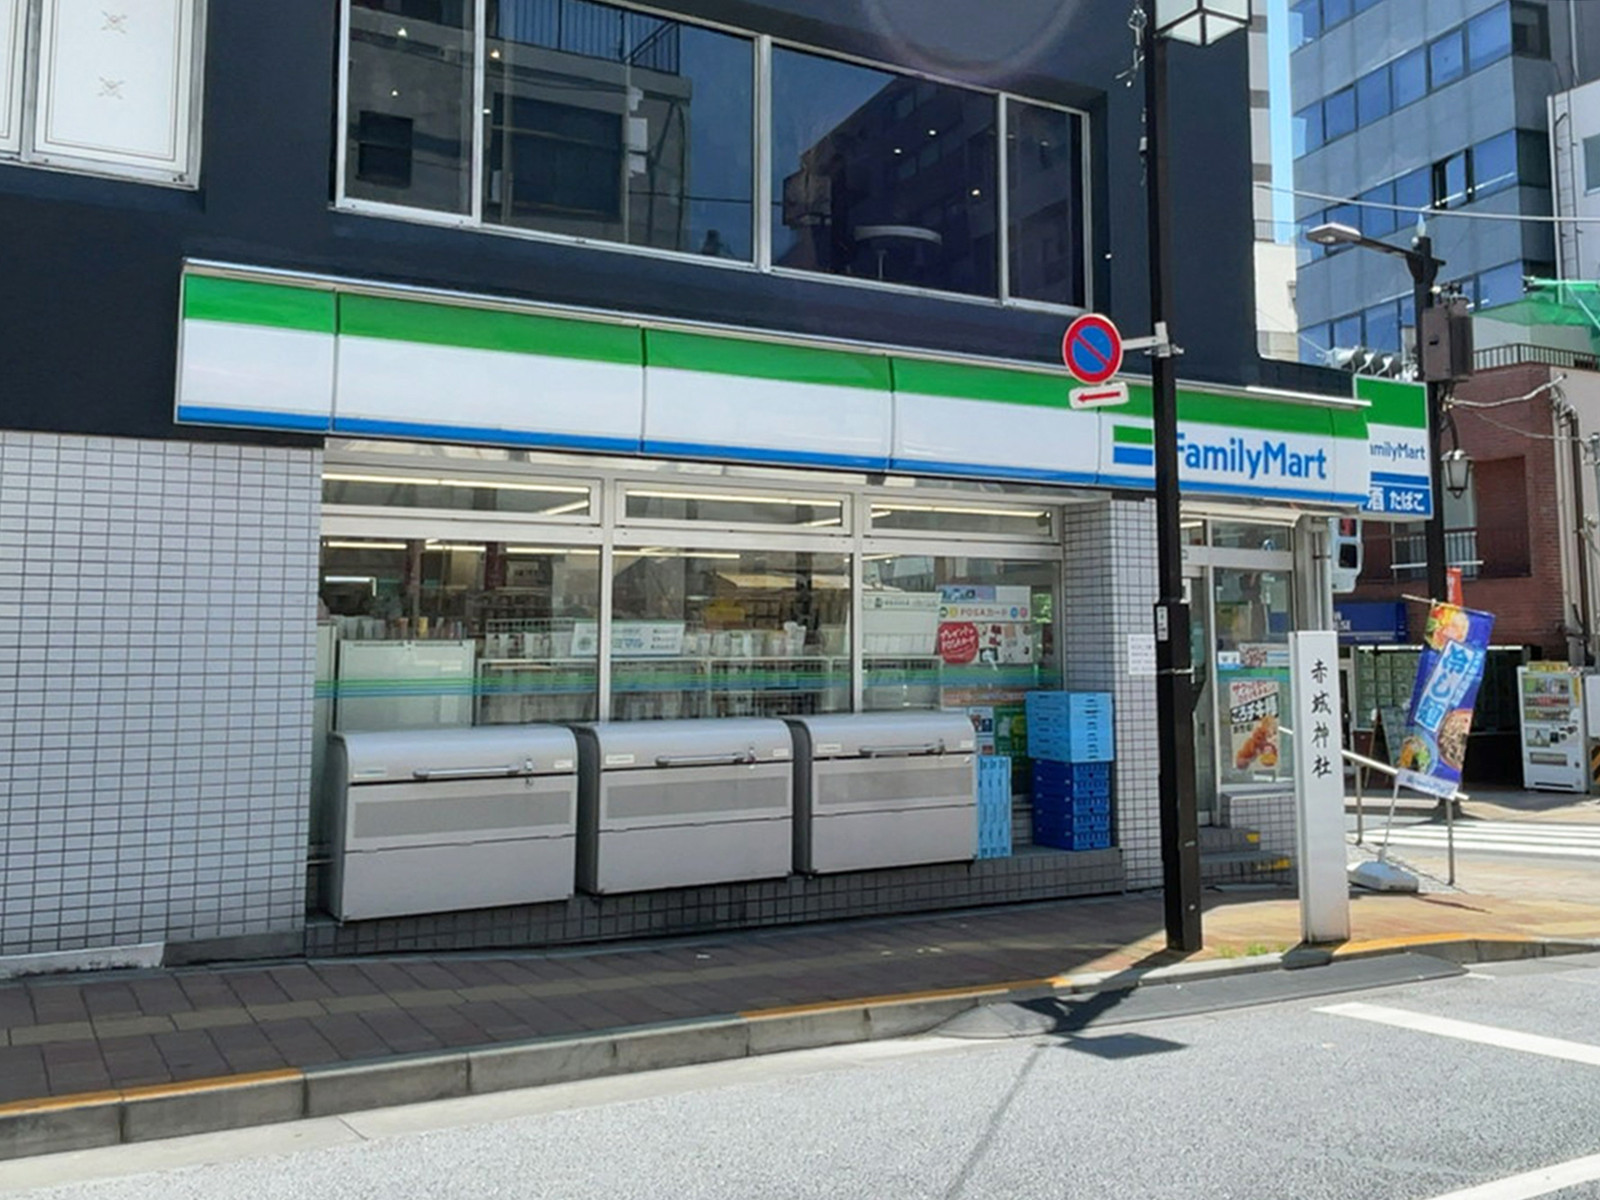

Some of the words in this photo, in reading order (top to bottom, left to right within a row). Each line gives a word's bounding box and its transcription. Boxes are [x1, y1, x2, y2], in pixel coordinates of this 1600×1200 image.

[1389, 491, 1425, 511] たばこ
[1310, 658, 1333, 779] 赤城神社
